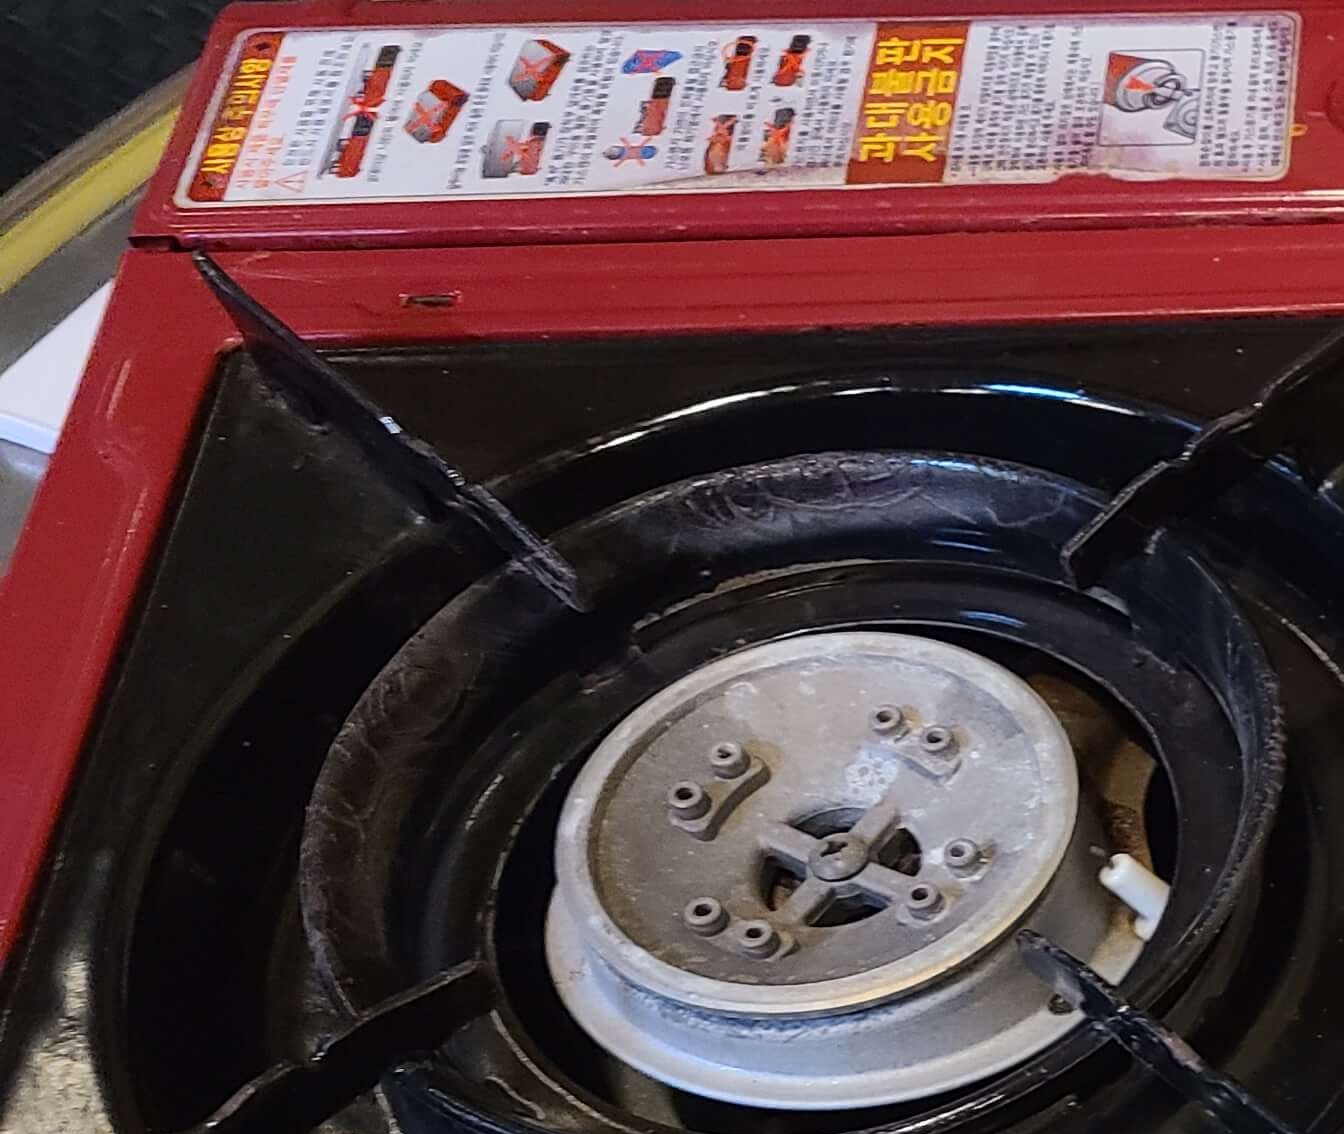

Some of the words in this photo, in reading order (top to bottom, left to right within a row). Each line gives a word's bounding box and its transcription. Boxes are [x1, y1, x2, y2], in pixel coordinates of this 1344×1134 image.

[223, 58, 272, 119] 주의사항
[857, 38, 922, 163] 과대불판
[903, 37, 966, 163] 사용금지
[201, 128, 248, 174] 사용상
